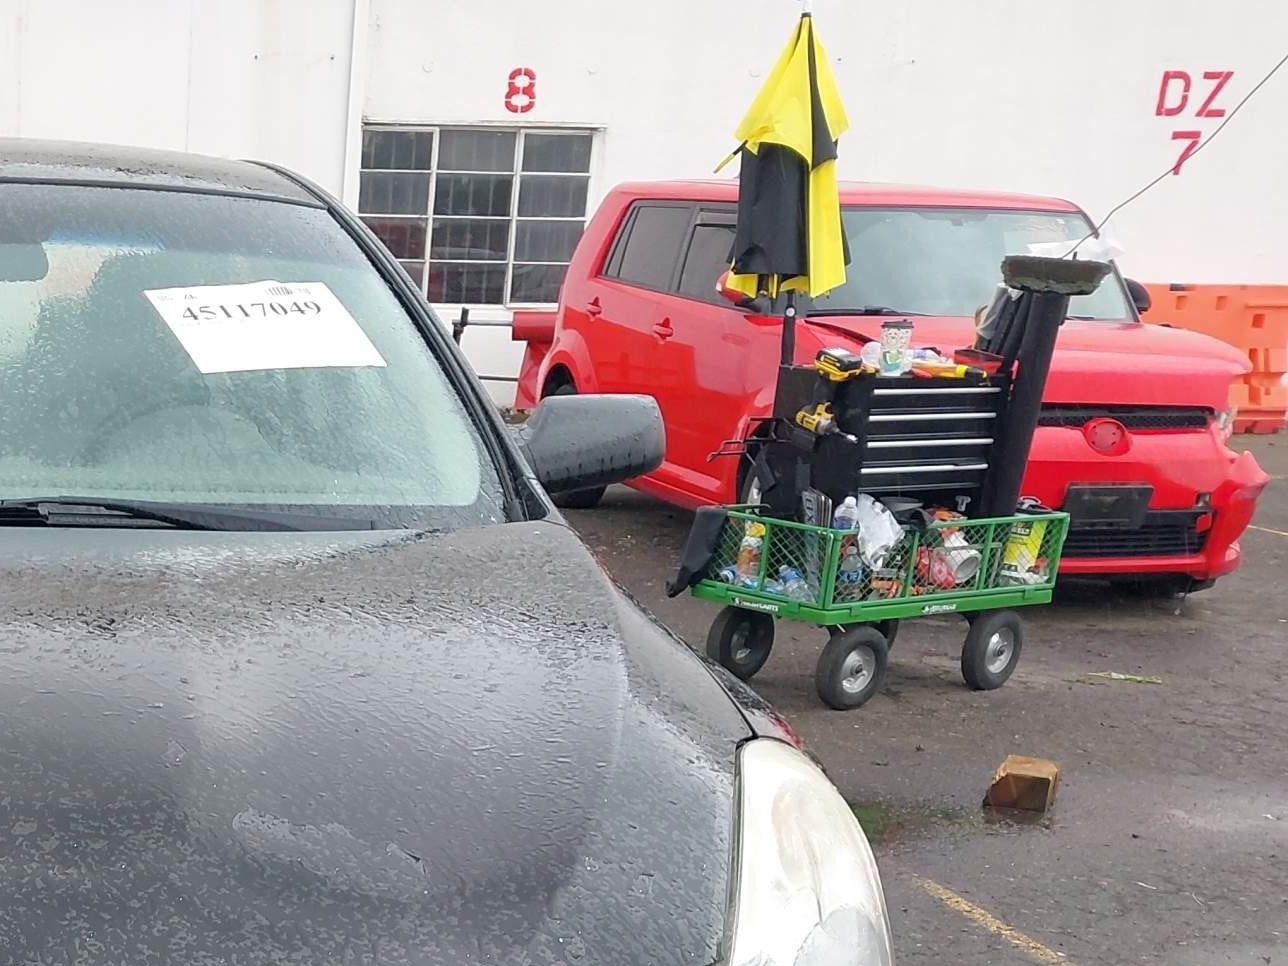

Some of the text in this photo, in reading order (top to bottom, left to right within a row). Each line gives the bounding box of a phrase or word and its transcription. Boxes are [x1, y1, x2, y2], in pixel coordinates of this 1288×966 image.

[503, 67, 537, 114] 8
[1155, 70, 1235, 118] DZ
[1170, 130, 1202, 177] 7
[182, 300, 322, 321] 45117049
